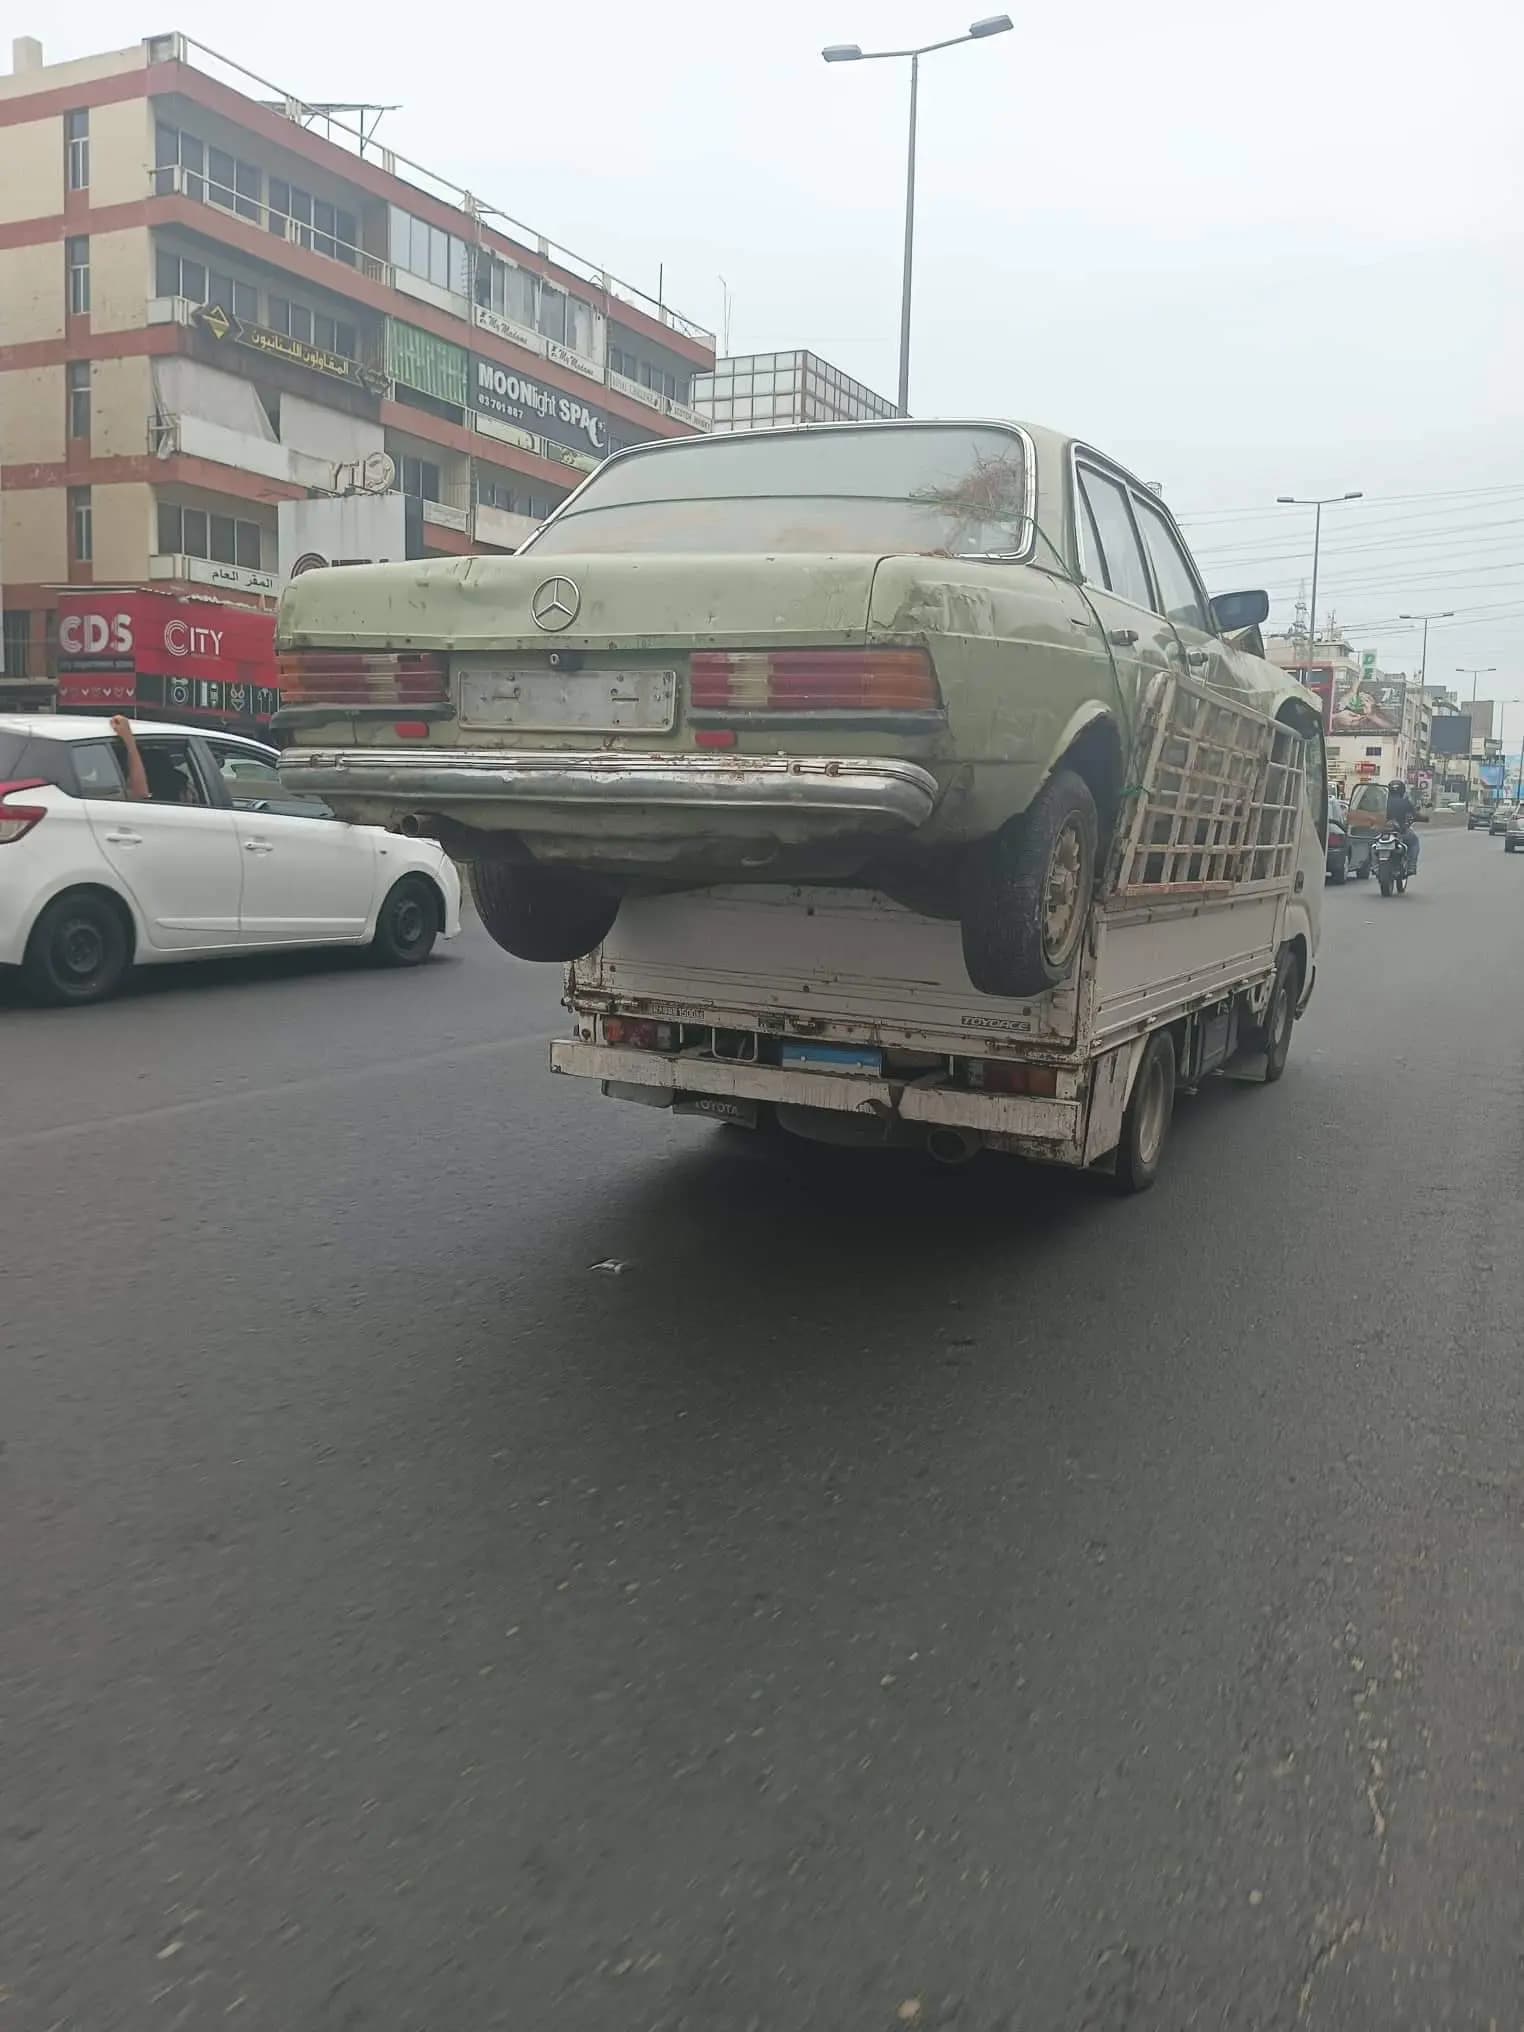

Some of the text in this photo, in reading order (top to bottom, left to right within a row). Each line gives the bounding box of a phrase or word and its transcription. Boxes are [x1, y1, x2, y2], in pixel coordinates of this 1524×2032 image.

[478, 362, 556, 417] MOONlight
[559, 398, 591, 429] SPA
[212, 569, 273, 588] المقر العام
[59, 613, 134, 653] CDS
[164, 619, 224, 656] CITY
